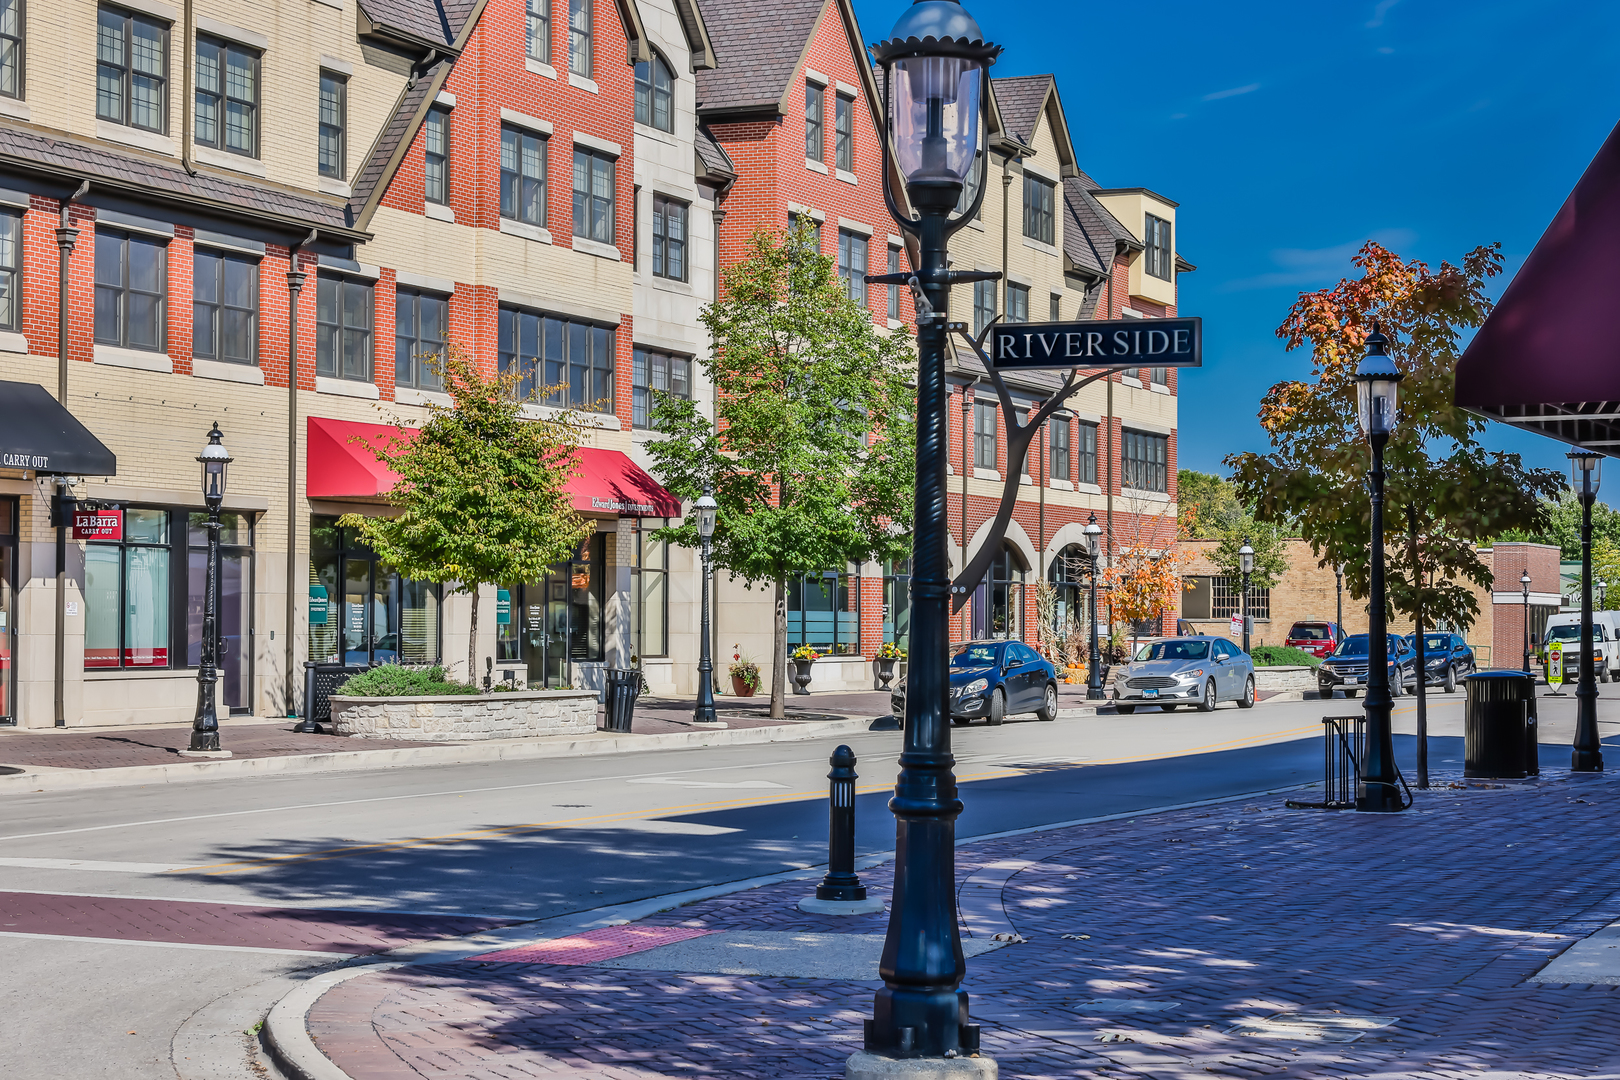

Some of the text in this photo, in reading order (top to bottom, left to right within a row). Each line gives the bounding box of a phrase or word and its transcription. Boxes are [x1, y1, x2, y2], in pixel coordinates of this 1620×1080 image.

[998, 329, 1191, 359] RIVERSIDE
[3, 453, 31, 467] CARRY
[32, 455, 49, 468] OUT
